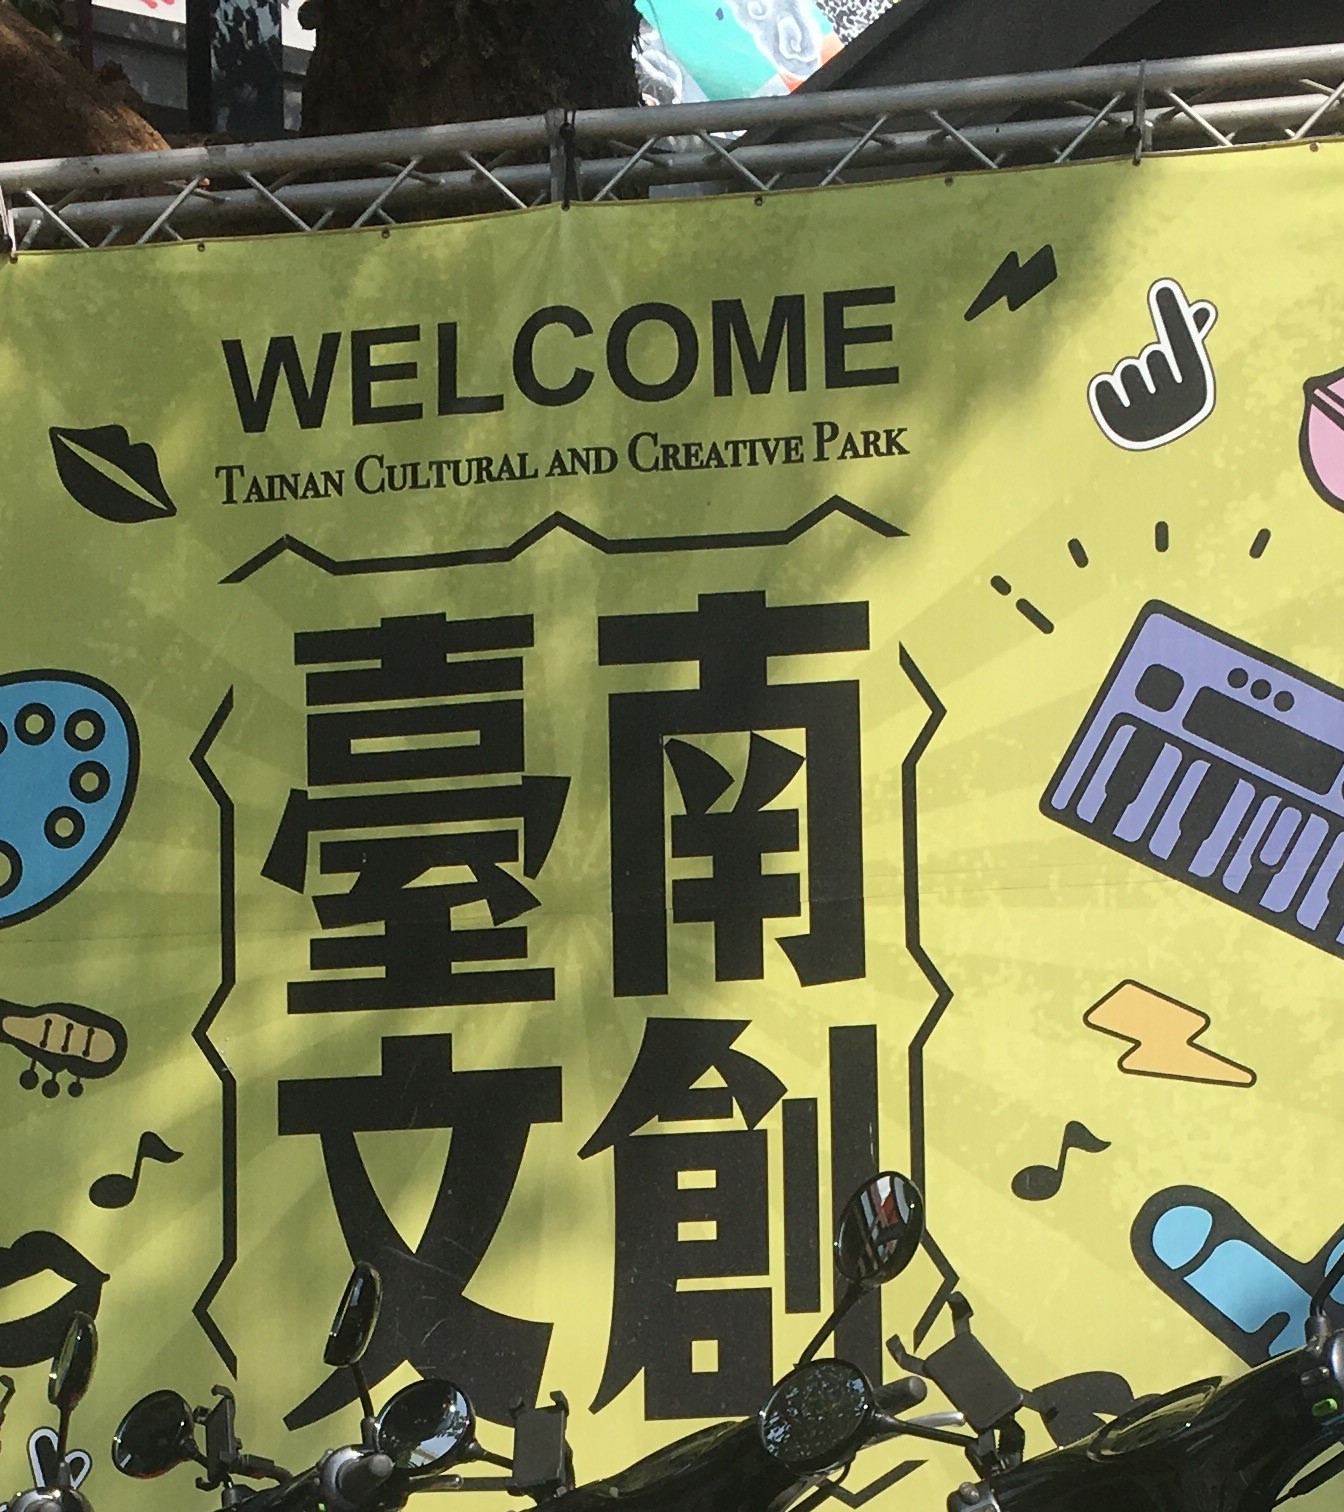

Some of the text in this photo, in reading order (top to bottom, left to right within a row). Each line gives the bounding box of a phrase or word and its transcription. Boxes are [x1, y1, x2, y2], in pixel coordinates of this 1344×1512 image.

[222, 286, 900, 434] WELCOME
[545, 445, 618, 477] AND
[260, 590, 870, 1014] 臺南
[277, 1017, 884, 1432] 文創
